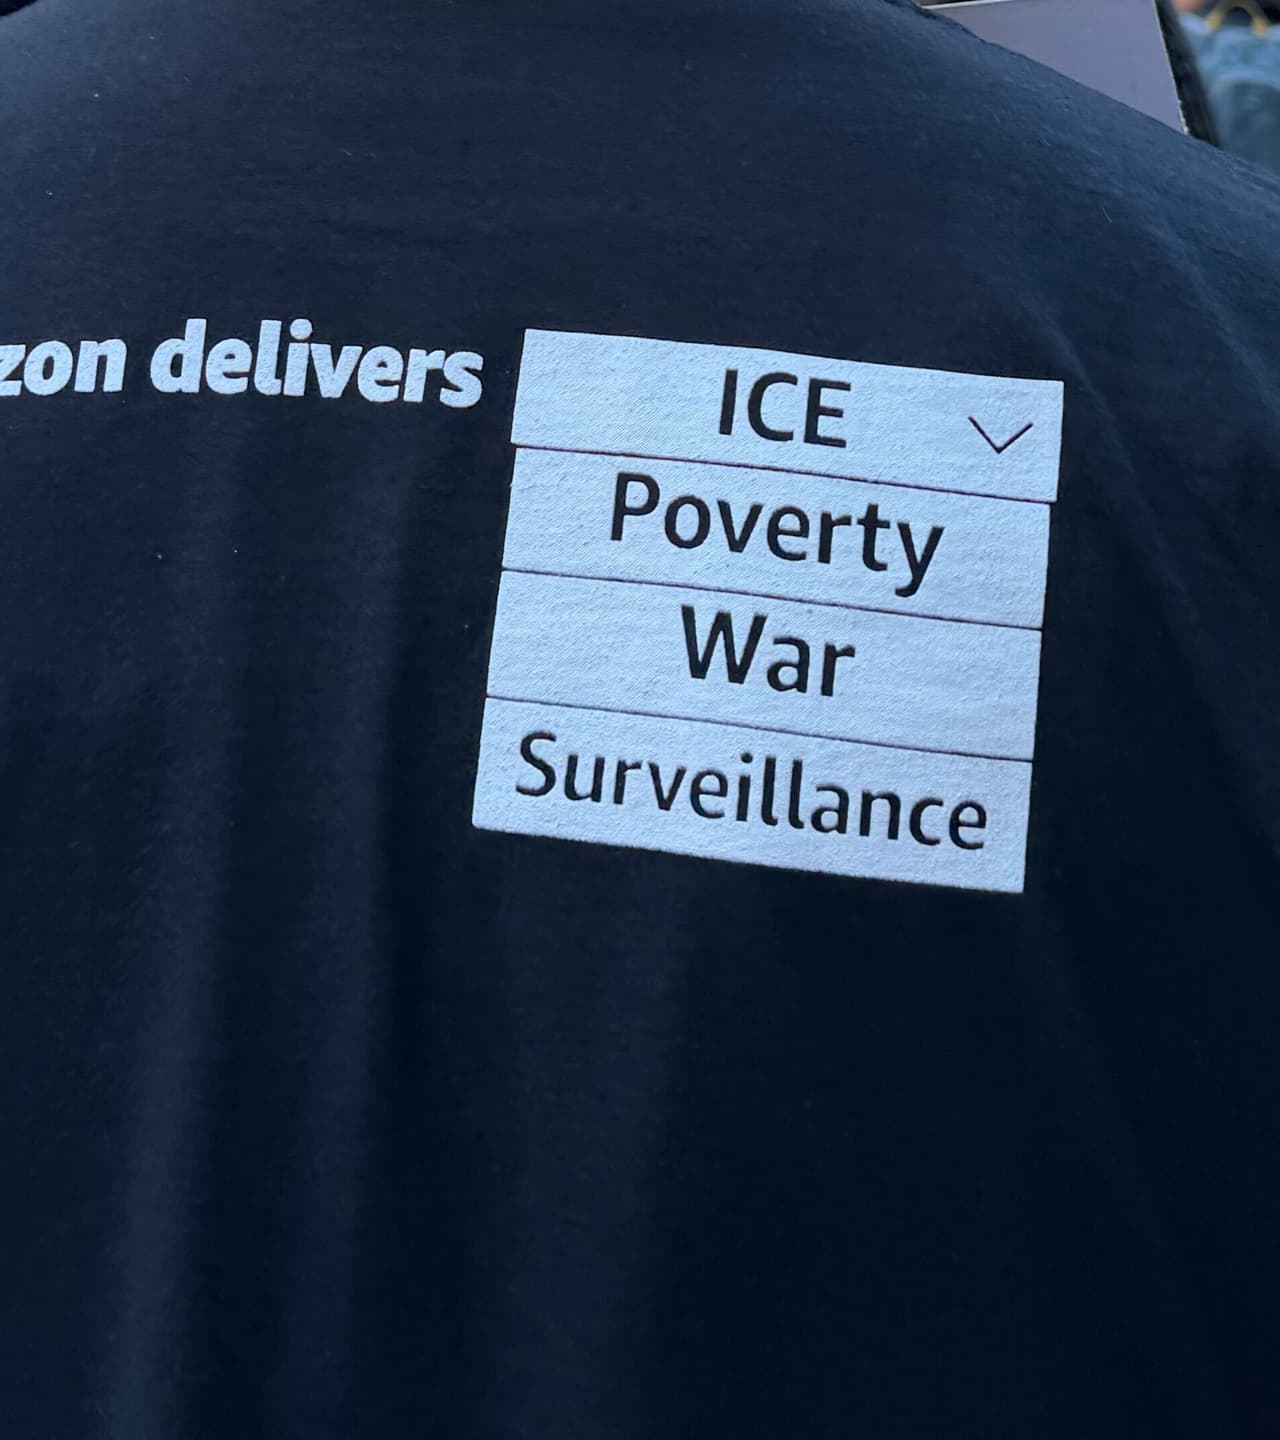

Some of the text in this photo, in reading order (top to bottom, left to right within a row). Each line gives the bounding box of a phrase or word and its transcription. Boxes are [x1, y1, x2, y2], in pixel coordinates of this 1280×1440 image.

[150, 318, 484, 408] delivers
[718, 368, 852, 449] ICE
[610, 471, 945, 599] Poverty
[680, 604, 856, 698] War
[515, 729, 987, 850] Surveillance
